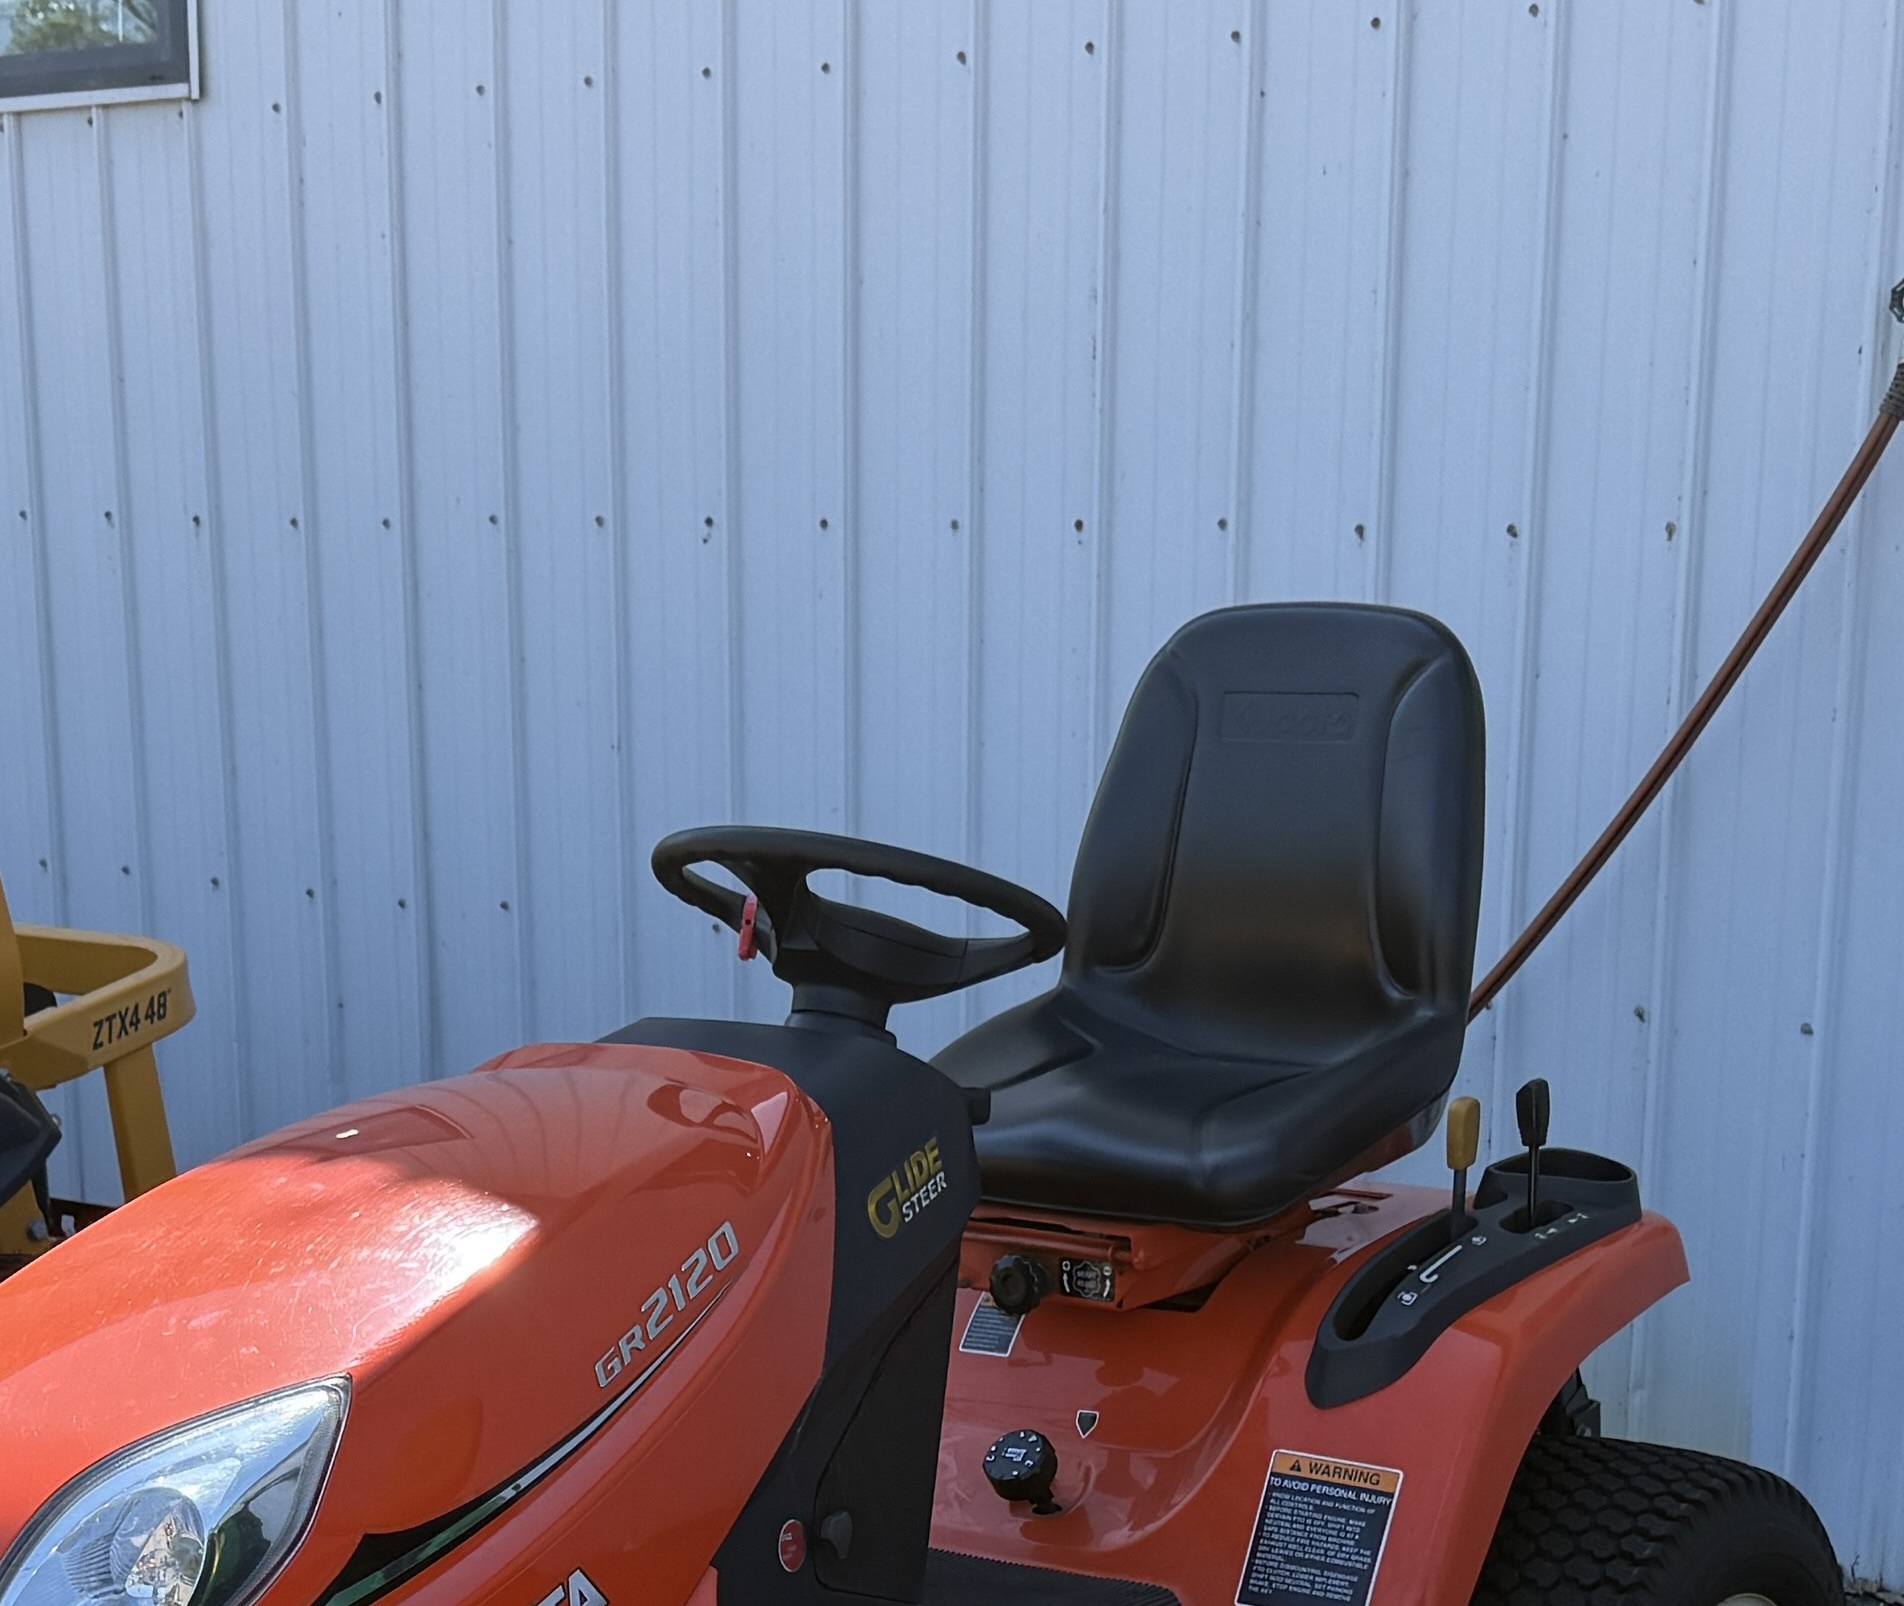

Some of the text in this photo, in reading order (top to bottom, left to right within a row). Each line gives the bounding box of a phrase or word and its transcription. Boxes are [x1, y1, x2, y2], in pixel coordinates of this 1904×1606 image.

[93, 1002, 141, 1051] ZTX4
[867, 1137, 943, 1239] GLIDE
[902, 1170, 948, 1223] STEER
[594, 1220, 739, 1388] GR2120
[1307, 1461, 1381, 1485] WARNING
